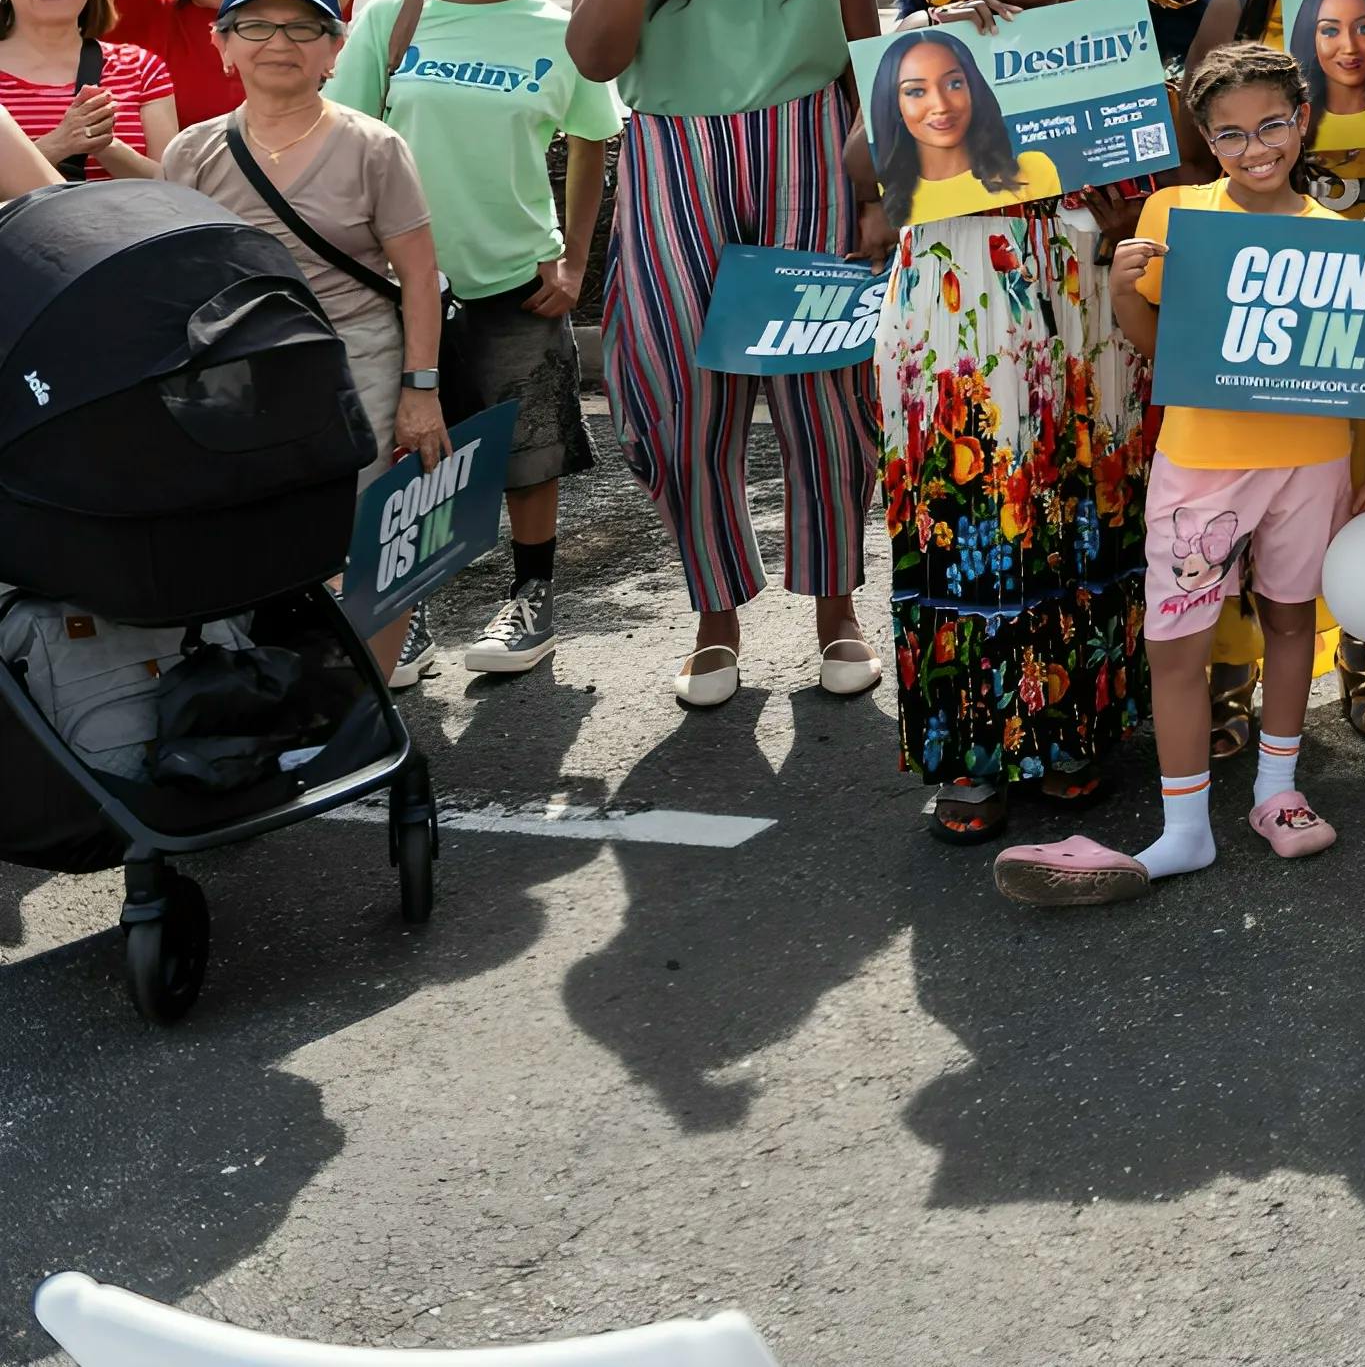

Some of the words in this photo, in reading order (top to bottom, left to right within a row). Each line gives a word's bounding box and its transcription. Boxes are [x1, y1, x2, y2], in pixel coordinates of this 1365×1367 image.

[994, 20, 1148, 80] Destiny!
[744, 313, 880, 356] OUNT
[1221, 305, 1298, 366] US
[1300, 311, 1365, 370] IN.
[380, 438, 482, 544] COUNT
[376, 524, 419, 592] US
[419, 497, 455, 563] IN.
